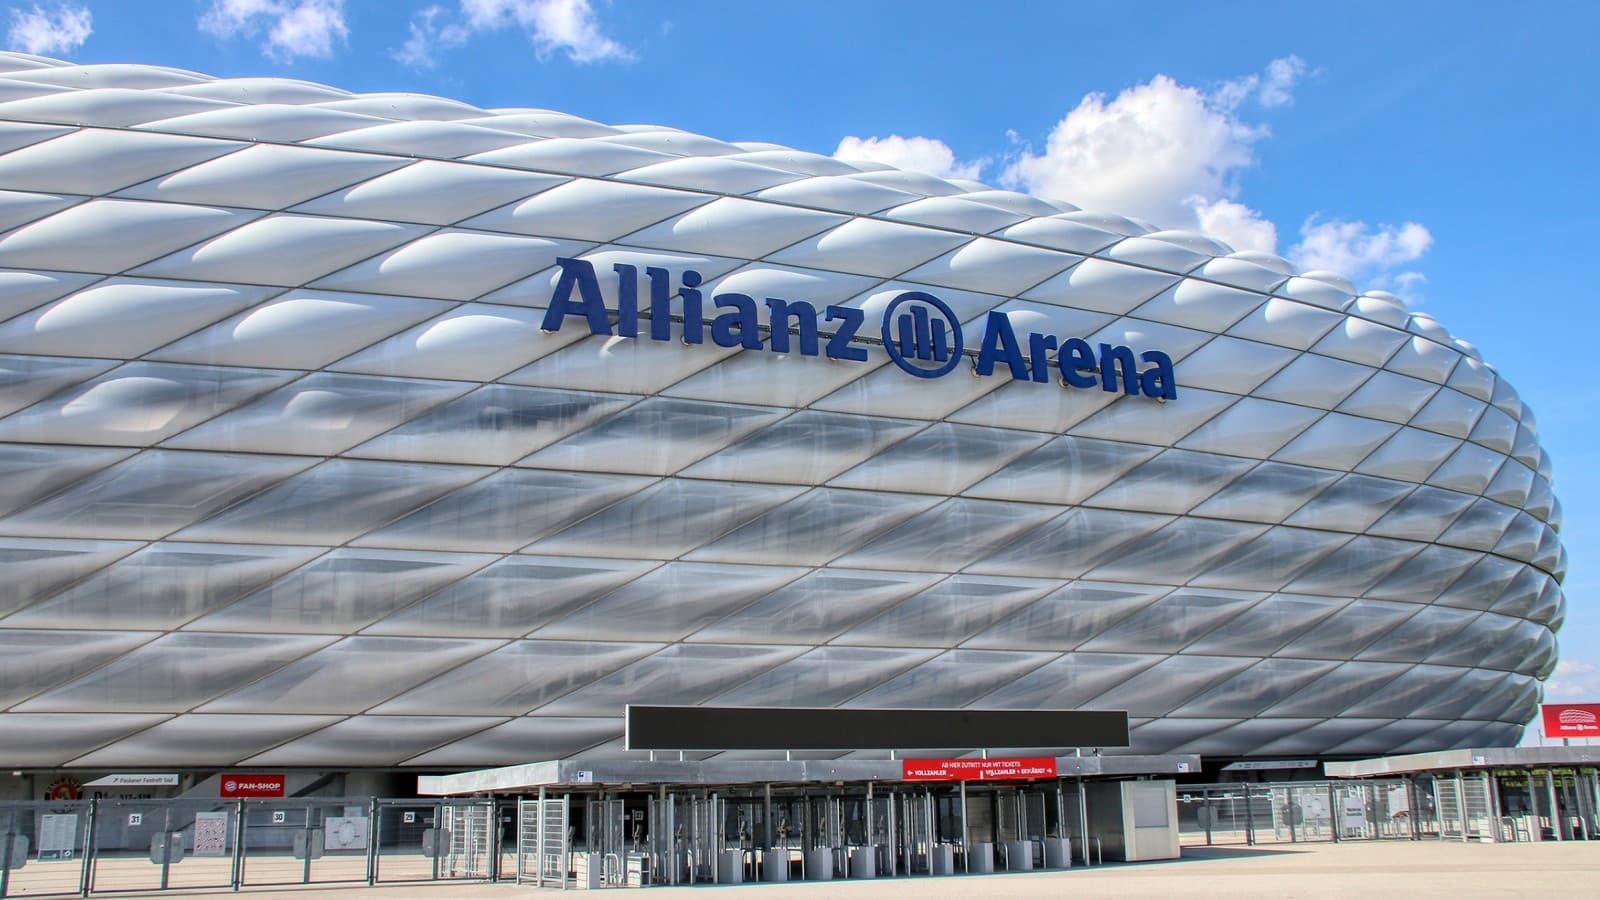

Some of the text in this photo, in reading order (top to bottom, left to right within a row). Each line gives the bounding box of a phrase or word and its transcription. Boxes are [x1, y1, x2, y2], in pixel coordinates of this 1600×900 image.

[541, 257, 1177, 401] Allianz Arena
[131, 815, 140, 823] 31
